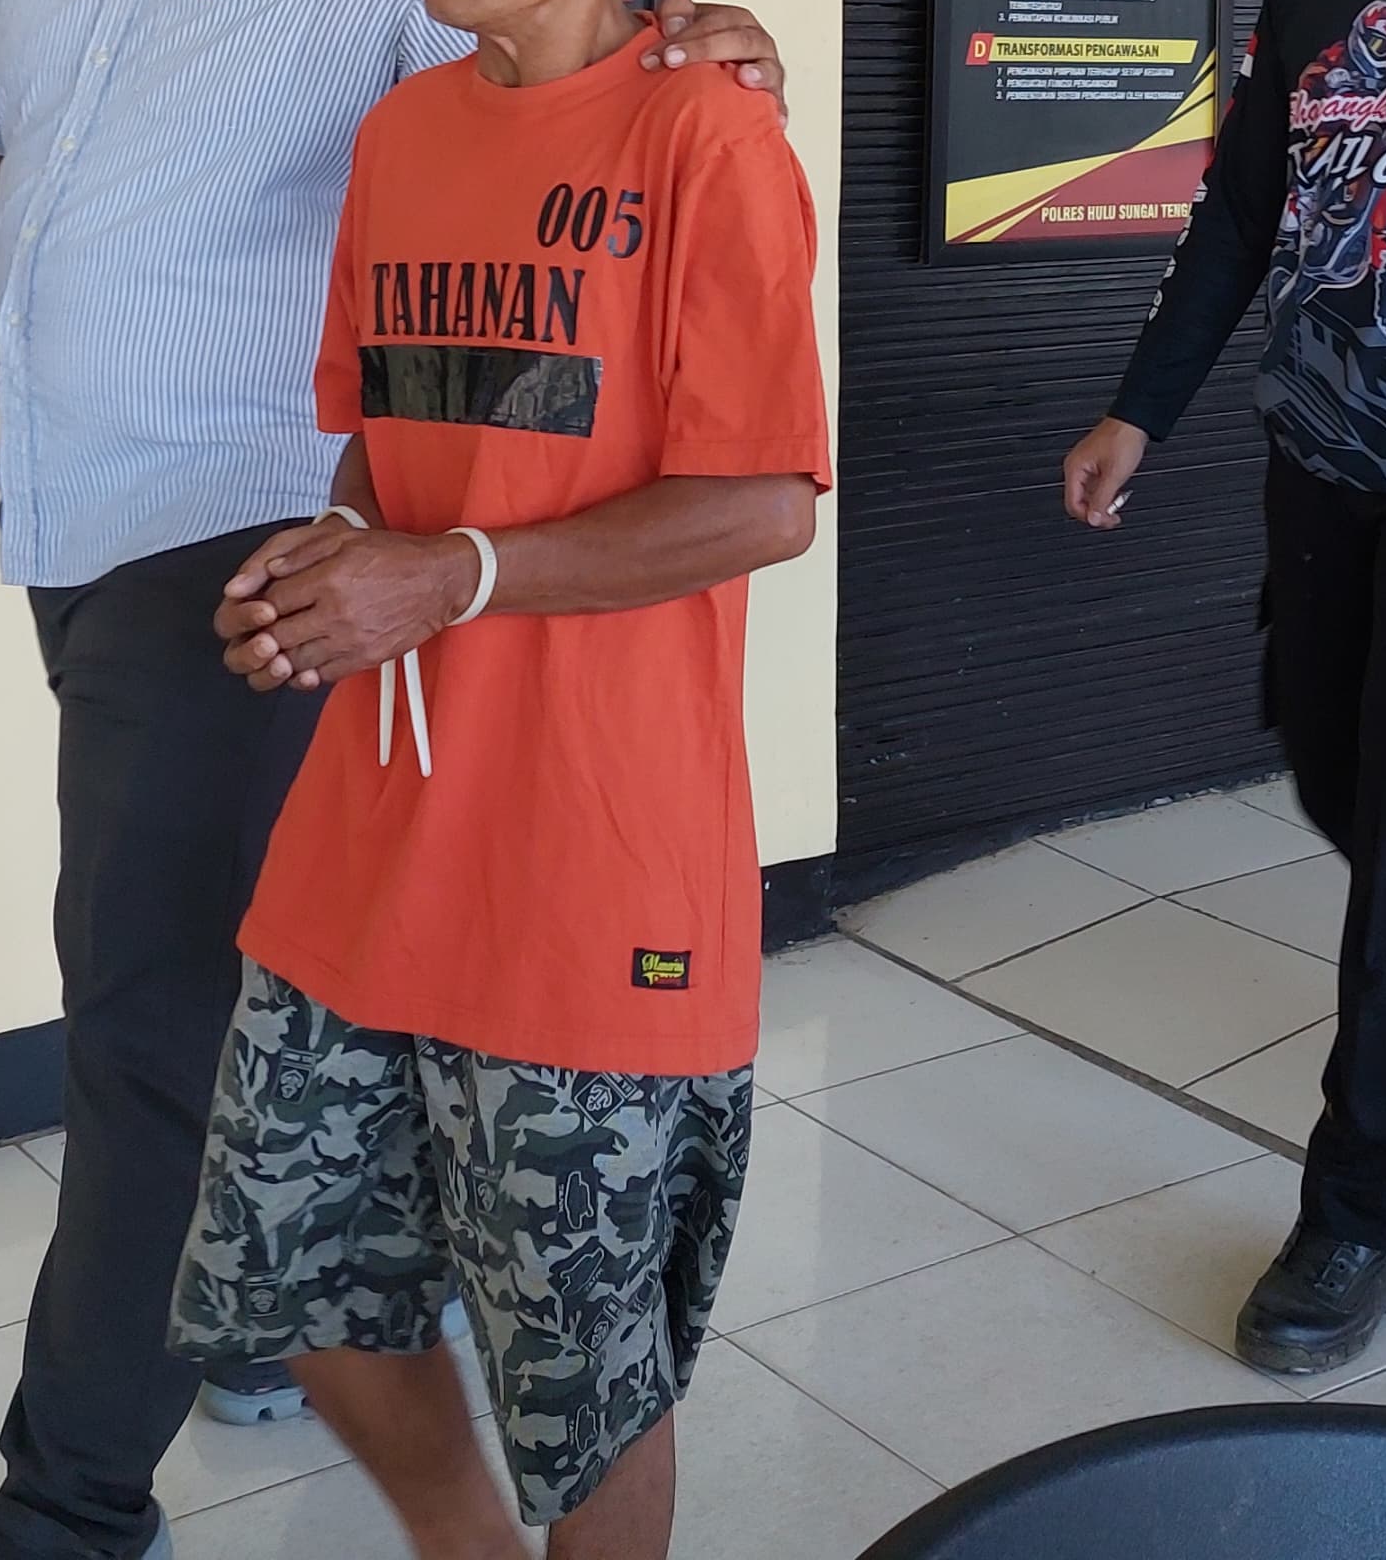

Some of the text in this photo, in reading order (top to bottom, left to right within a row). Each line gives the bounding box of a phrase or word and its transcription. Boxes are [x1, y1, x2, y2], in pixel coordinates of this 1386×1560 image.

[974, 40, 1160, 58] D TRANSFORMASI PENGAWASAN
[537, 183, 644, 259] 005
[1041, 202, 1191, 224] POLRES HULU SUNGAI TENG
[372, 262, 585, 345] TAHANAN
